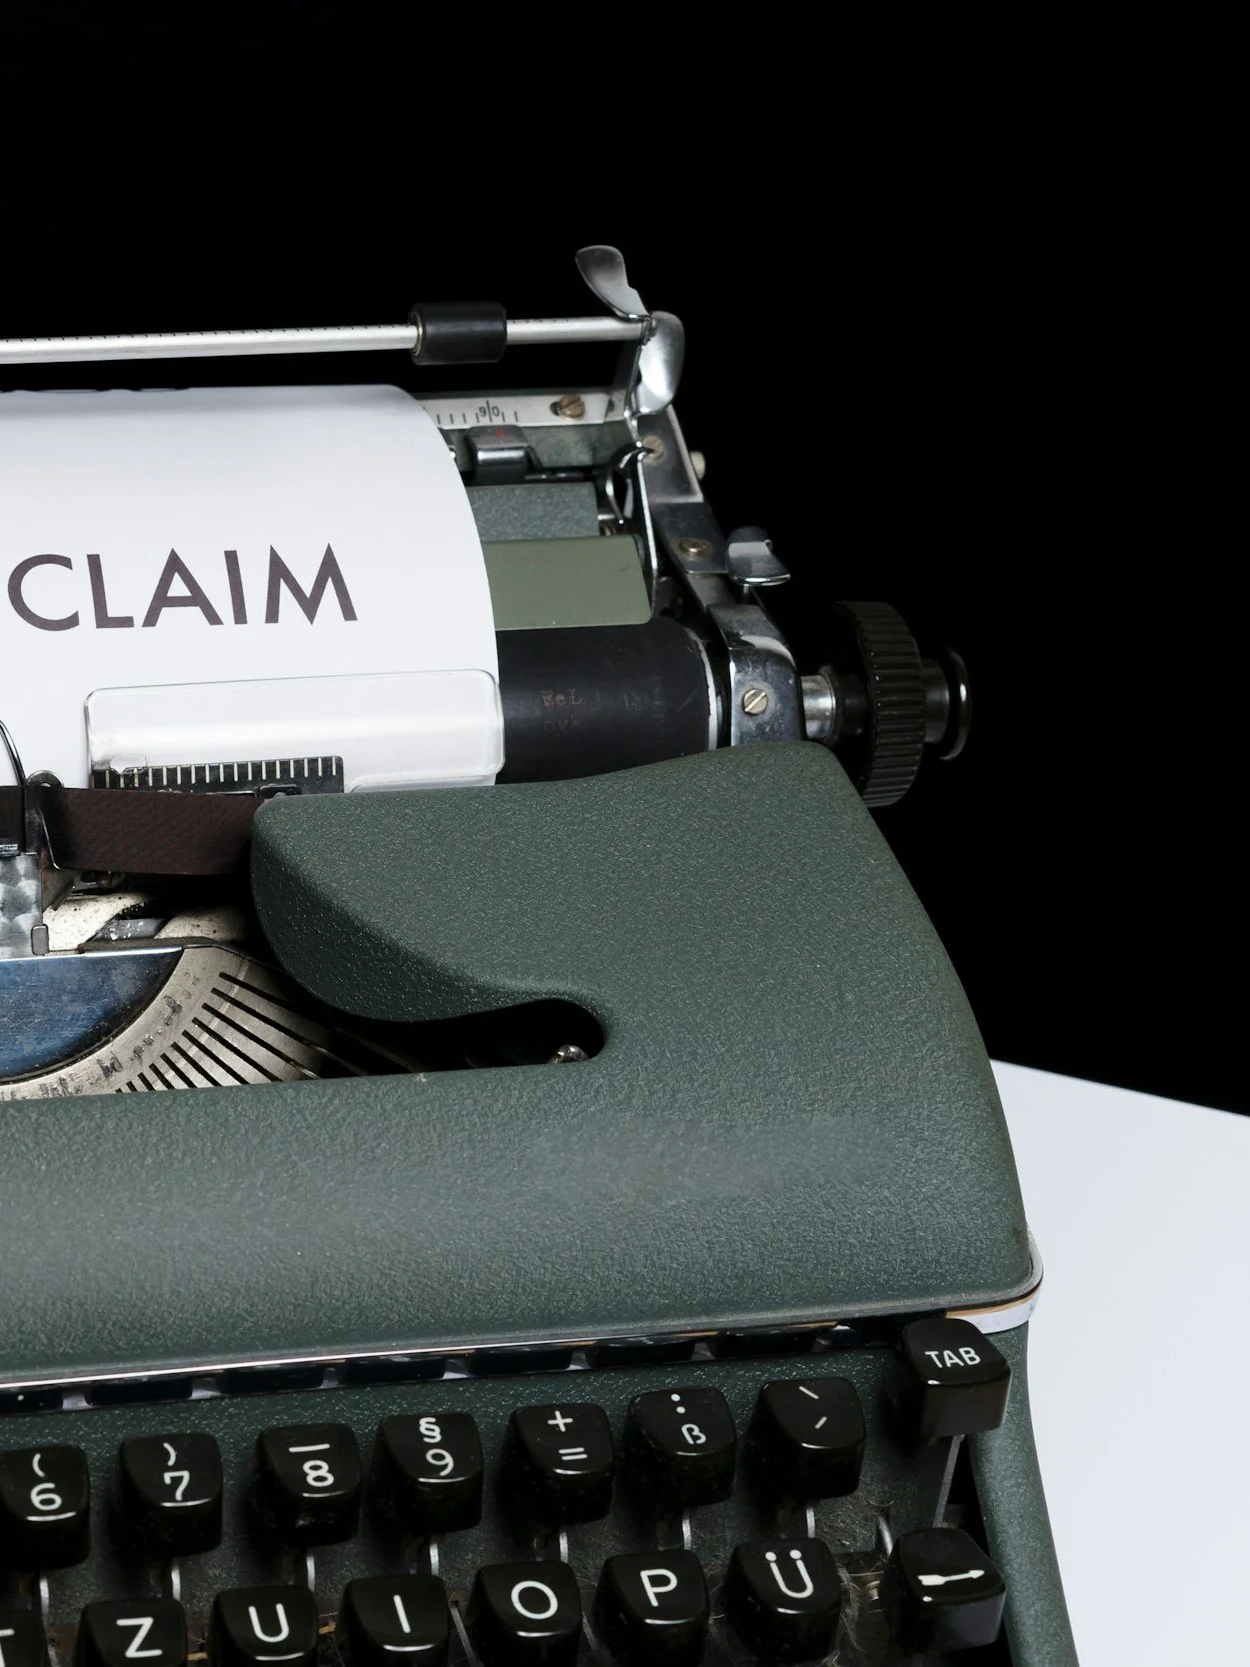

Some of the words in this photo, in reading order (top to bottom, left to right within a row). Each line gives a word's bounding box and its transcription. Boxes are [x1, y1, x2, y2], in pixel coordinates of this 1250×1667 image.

[7, 543, 358, 632] CLAIM
[924, 1345, 982, 1370] TAB
[418, 1416, 442, 1444] §
[547, 1410, 574, 1432] +
[32, 1453, 45, 1477] (
[163, 1442, 177, 1467] )
[425, 1448, 454, 1477] 9
[558, 1447, 588, 1461] =
[163, 1470, 190, 1500] 7
[302, 1459, 335, 1487] 8
[30, 1482, 62, 1511] 6
[639, 1568, 678, 1607] P
[765, 1549, 814, 1599] Ü
[393, 1594, 411, 1634] I
[510, 1580, 559, 1620] O
[116, 1616, 163, 1658] Z
[248, 1603, 290, 1643] U
